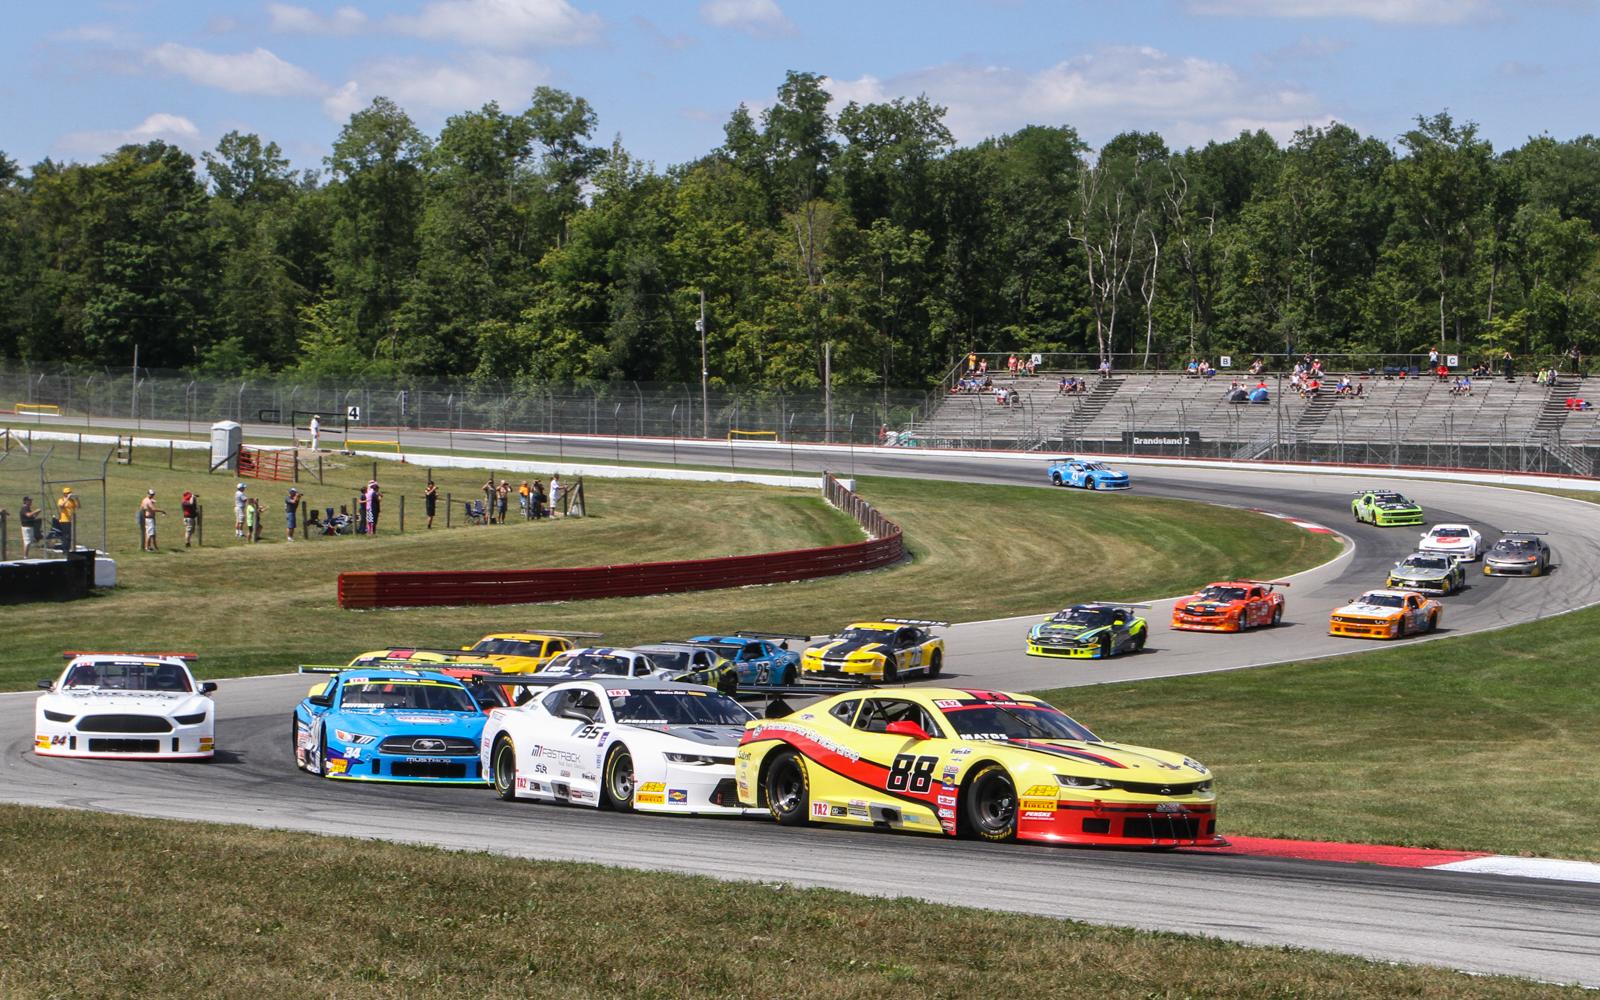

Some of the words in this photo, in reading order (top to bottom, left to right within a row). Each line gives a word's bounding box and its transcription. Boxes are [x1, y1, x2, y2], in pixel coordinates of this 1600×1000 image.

[1449, 357, 1456, 365] C
[349, 407, 359, 420] 4
[1133, 436, 1183, 445] Grandstand
[1184, 437, 1190, 445] 2
[755, 661, 770, 684] 25
[578, 726, 603, 739] 95
[960, 733, 1009, 741] MATOS
[51, 735, 67, 746] 24
[344, 747, 361, 759] 34
[886, 753, 940, 794] 88
[517, 777, 527, 788] TA2
[638, 794, 663, 803] PIRELLI
[813, 803, 828, 816] TA2
[1023, 800, 1055, 809] PIRELLI
